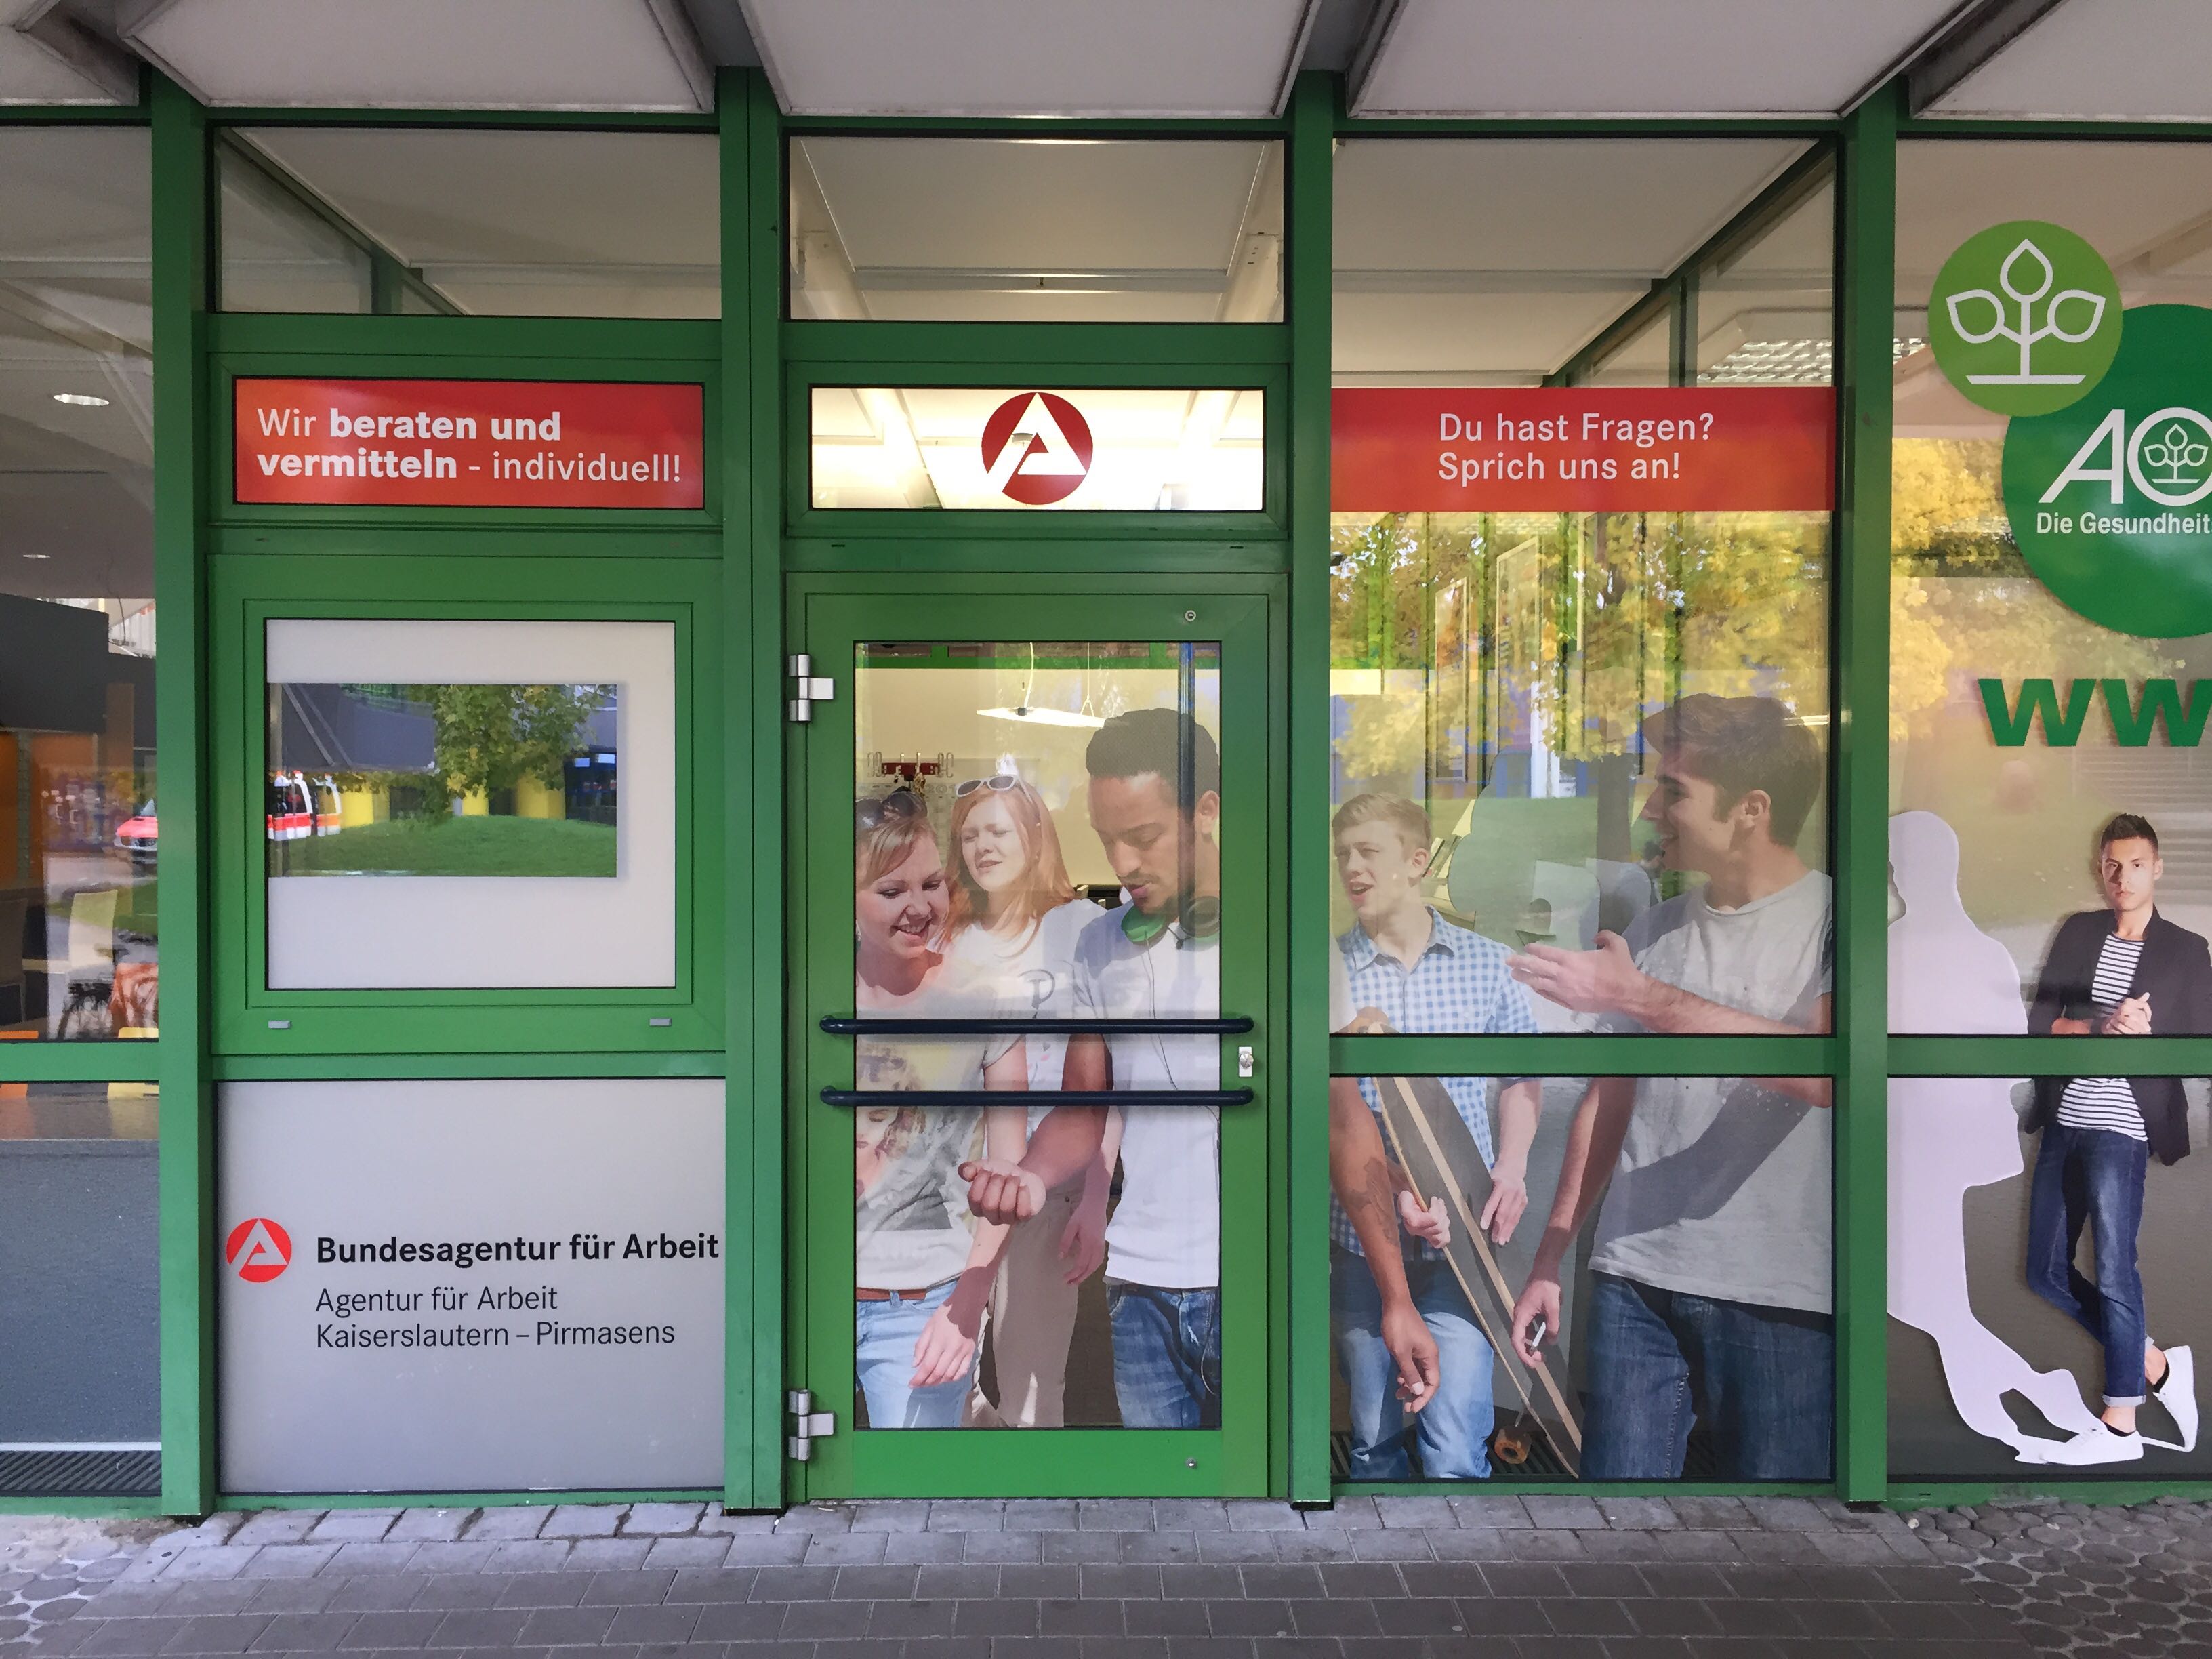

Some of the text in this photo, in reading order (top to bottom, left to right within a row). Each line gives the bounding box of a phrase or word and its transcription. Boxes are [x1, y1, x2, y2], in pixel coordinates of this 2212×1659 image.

[257, 407, 561, 441] Wir beraten und
[1439, 413, 1715, 448] Du hast Fragen?
[257, 447, 457, 478] vermitteln
[493, 450, 681, 483] individuell!
[1438, 451, 1680, 488] Sprich uns an!
[2036, 512, 2212, 535] Die Gesundheit
[316, 1233, 720, 1269] Bundesagentur für Arbeit
[315, 1286, 558, 1318] Agentur für Arbeit
[316, 1322, 509, 1348] Kaiserslautern
[536, 1320, 676, 1346] Pirmasens
